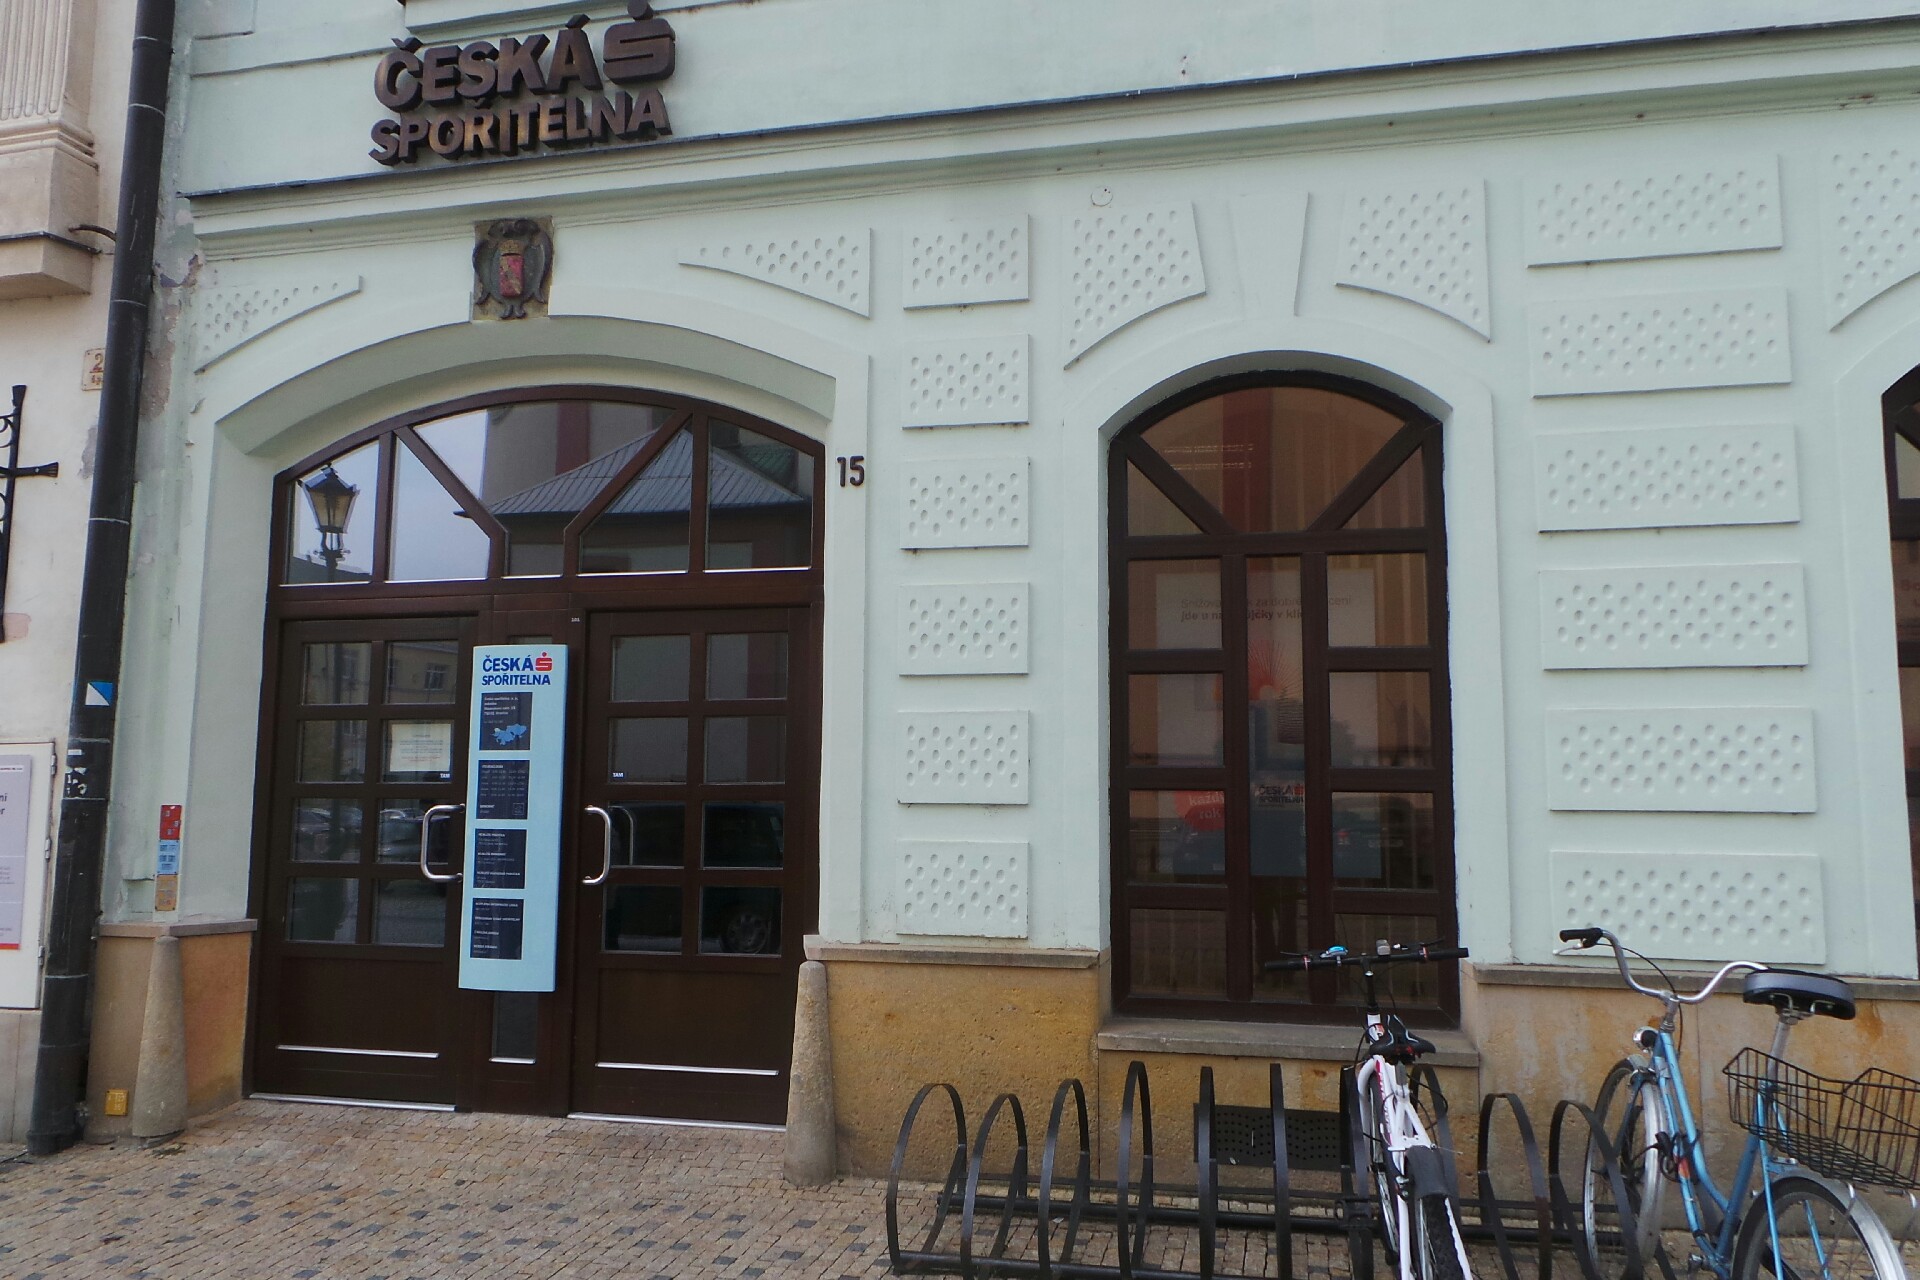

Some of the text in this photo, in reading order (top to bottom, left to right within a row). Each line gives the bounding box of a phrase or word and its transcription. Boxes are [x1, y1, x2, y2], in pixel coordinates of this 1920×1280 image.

[374, 14, 603, 113] ČESKÁ
[368, 88, 672, 166] SPOŘITELNA
[837, 455, 864, 487] 15
[481, 673, 551, 686] SPOŘITELNA
[482, 655, 534, 673] ČESKÁ
